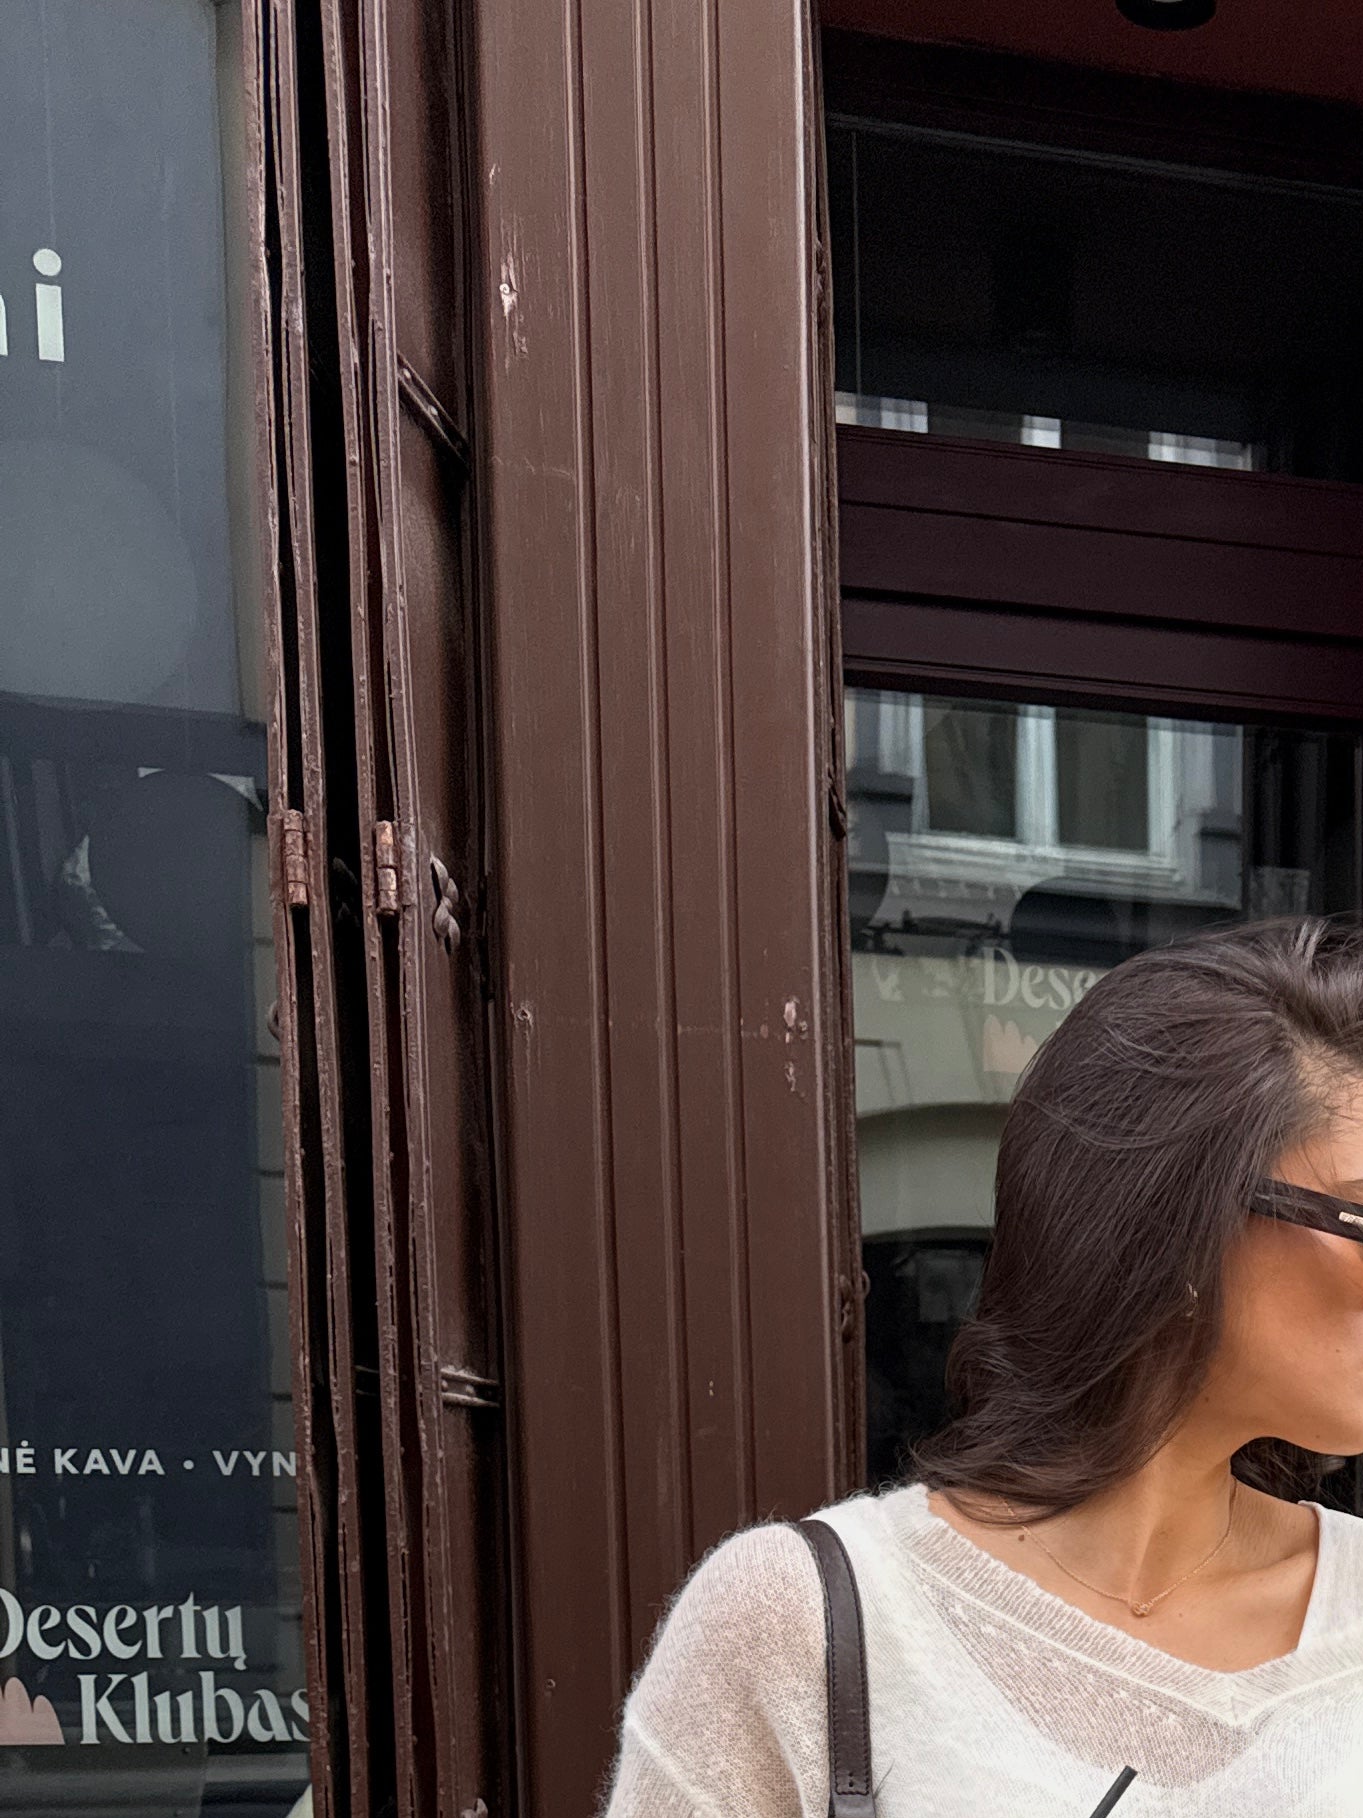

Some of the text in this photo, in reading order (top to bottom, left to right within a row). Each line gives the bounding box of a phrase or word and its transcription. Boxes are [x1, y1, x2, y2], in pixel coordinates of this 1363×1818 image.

[54, 1448, 165, 1475] KAVA
[212, 1450, 297, 1476] VYN
[77, 1671, 312, 1745] Klubas
